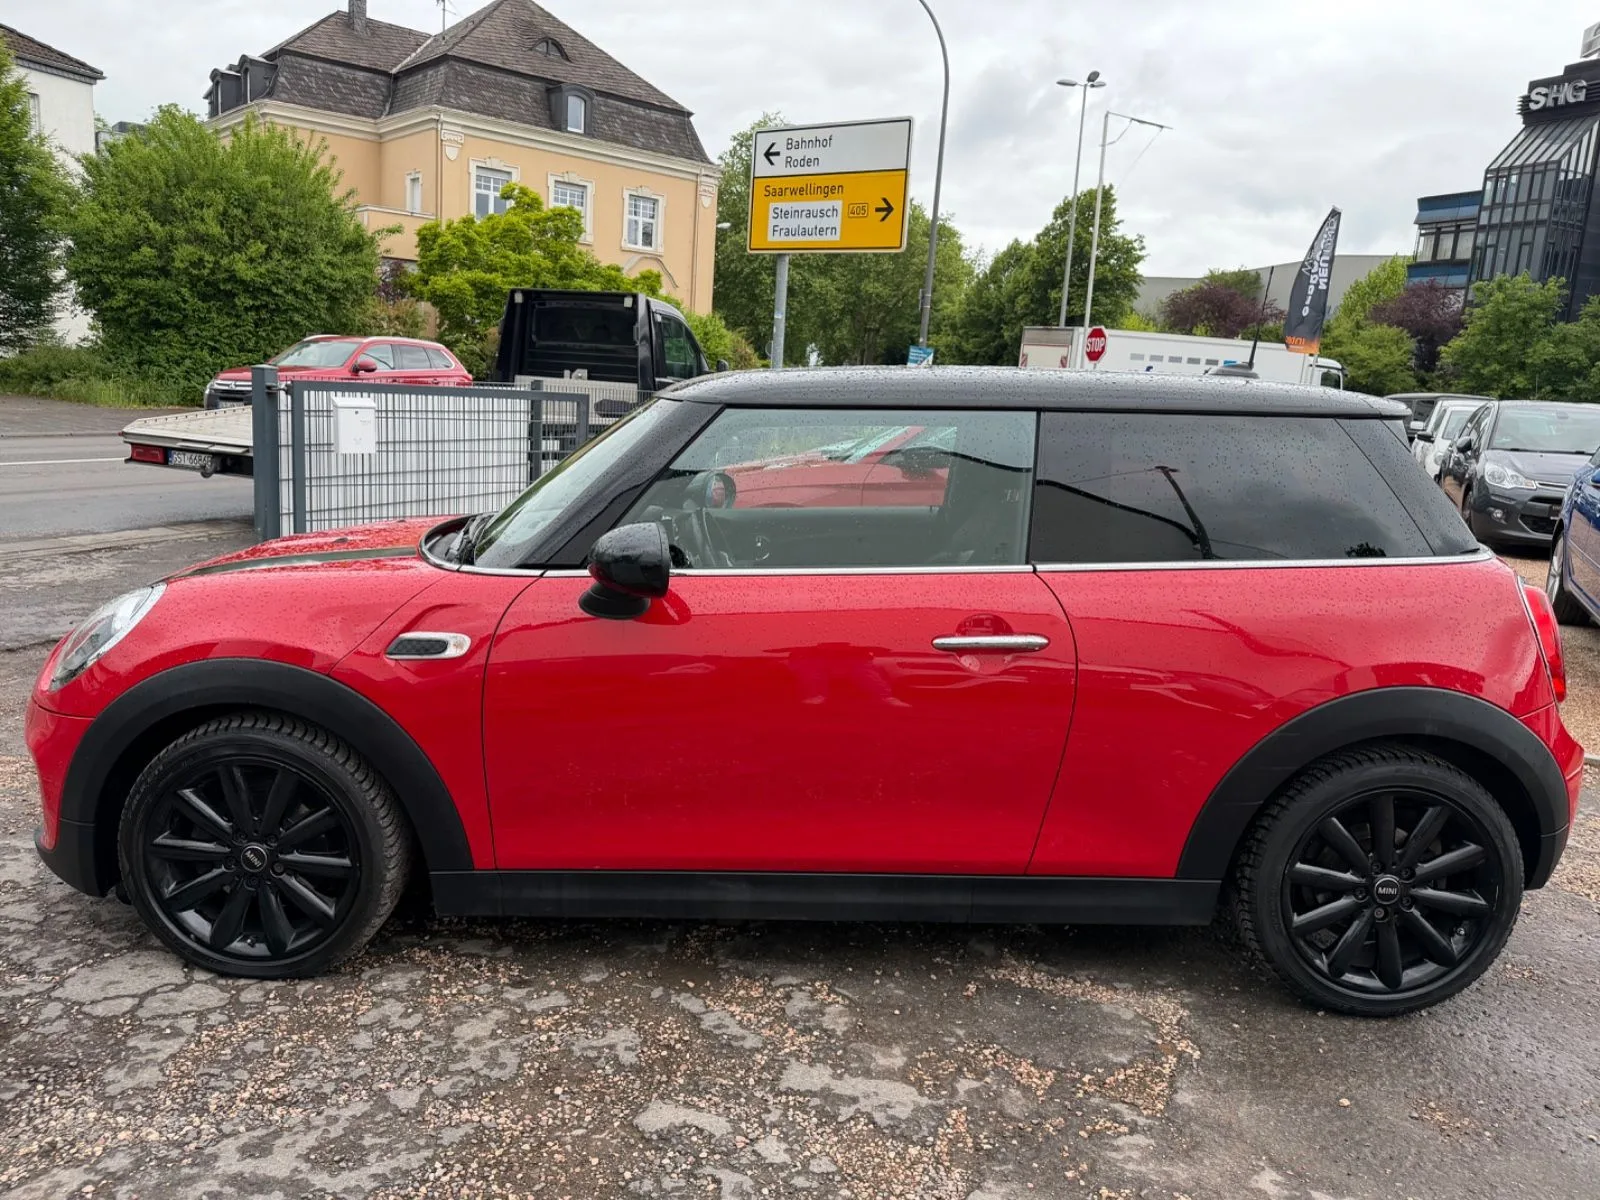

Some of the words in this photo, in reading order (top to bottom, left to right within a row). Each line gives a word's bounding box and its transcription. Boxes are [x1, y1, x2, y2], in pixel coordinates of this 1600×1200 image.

[1528, 79, 1588, 110] SHG
[786, 135, 833, 150] Bahnhof
[785, 156, 820, 168] Roden
[764, 183, 844, 198] Saarwellingen
[772, 206, 838, 219] Steinrausch
[850, 205, 867, 216] 405
[772, 225, 837, 237] Fraulautern
[1086, 337, 1105, 352] STOP
[245, 850, 261, 867] MINI
[1377, 886, 1397, 895] MINI
